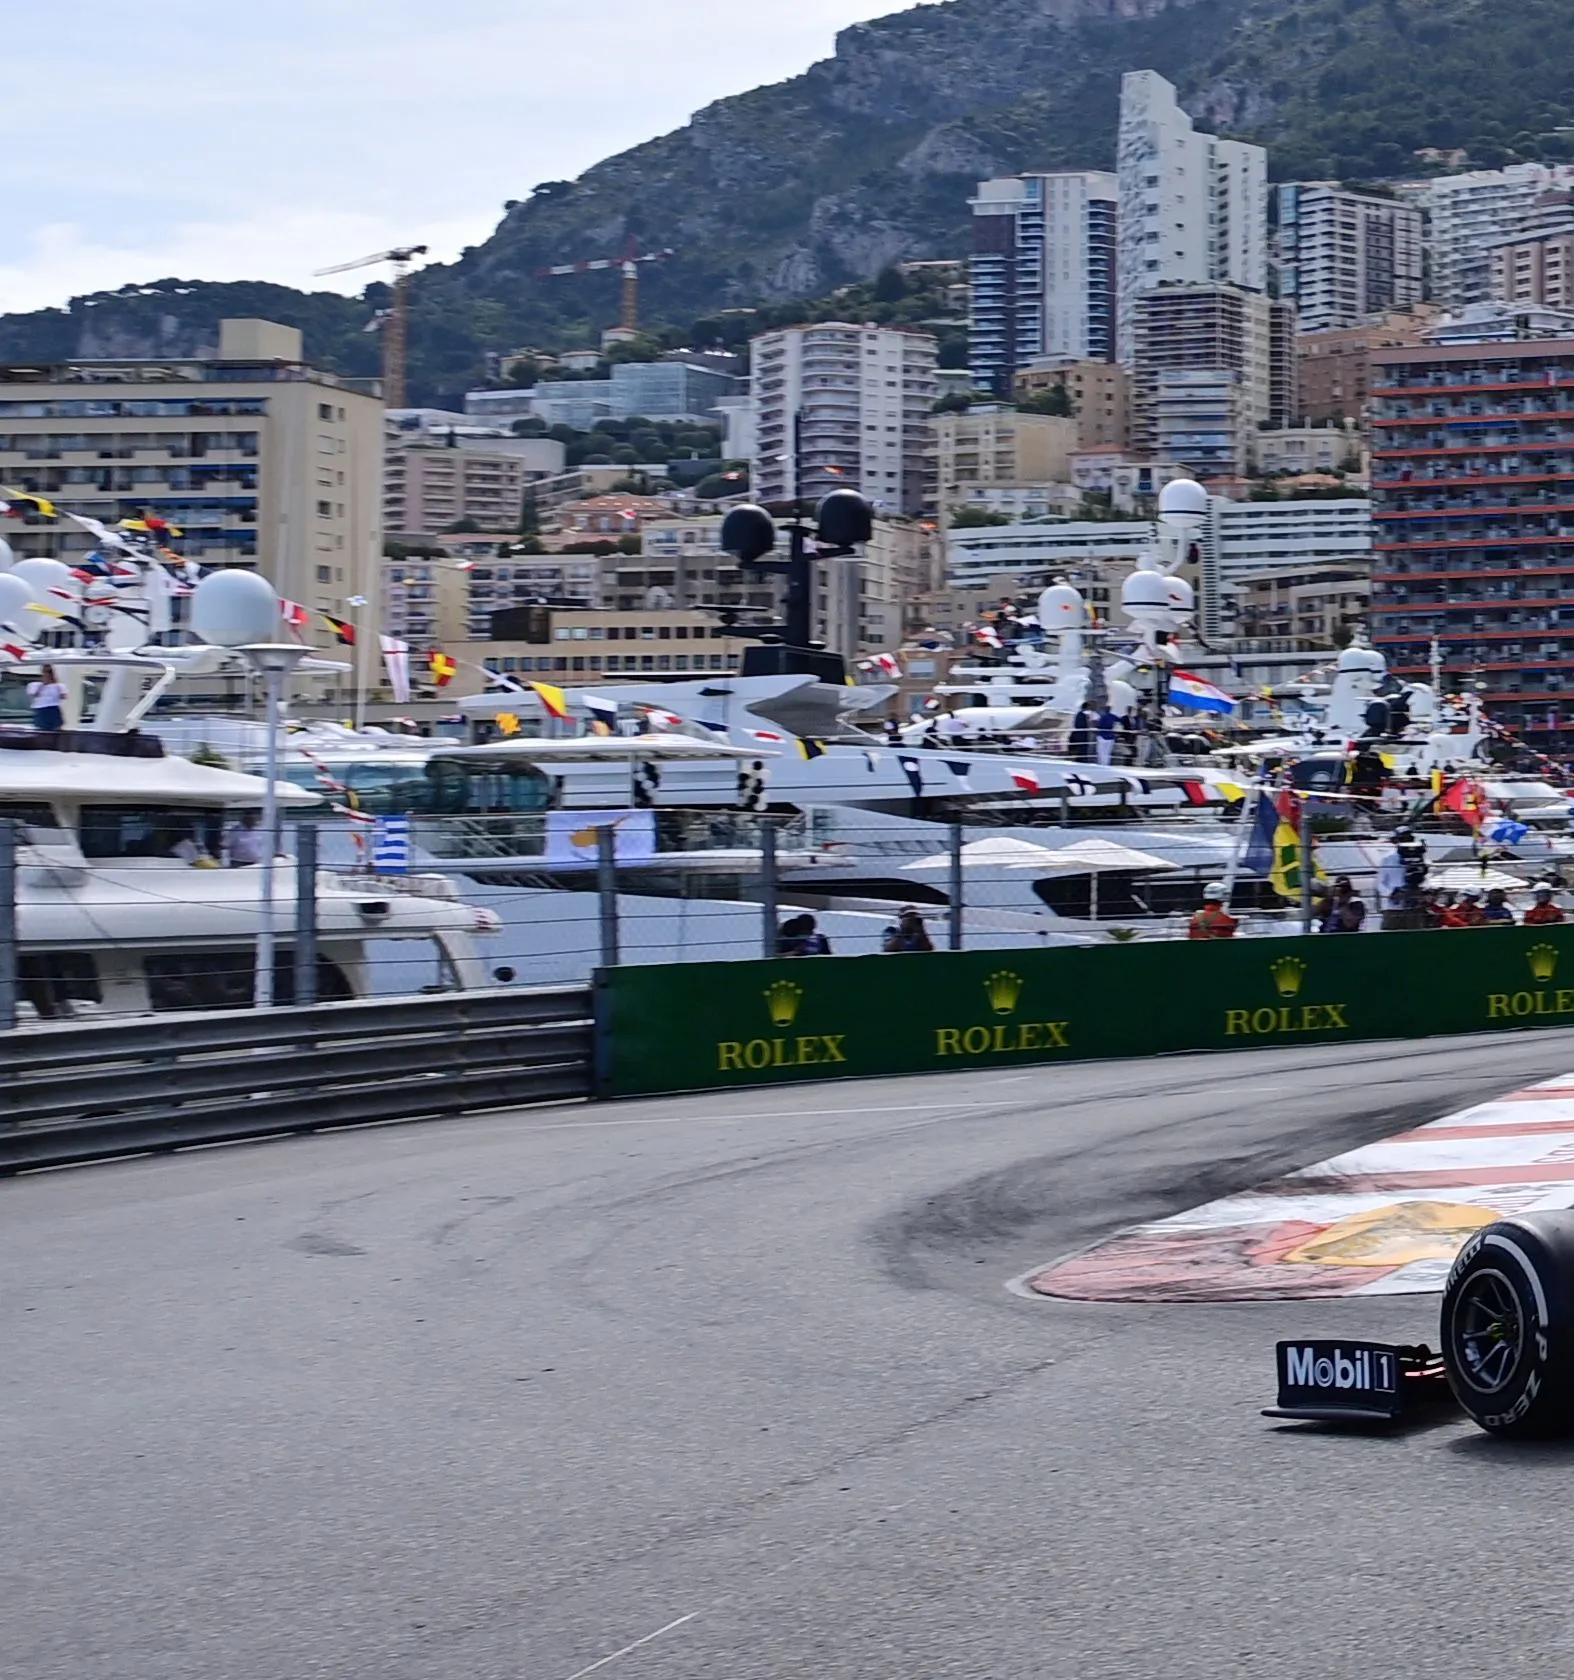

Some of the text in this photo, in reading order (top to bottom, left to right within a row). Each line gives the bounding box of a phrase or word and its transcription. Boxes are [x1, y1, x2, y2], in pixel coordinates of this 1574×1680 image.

[1225, 1004, 1349, 1035] ROLEX
[717, 1035, 847, 1071] ROLEX
[934, 1021, 1070, 1057] ROLEX
[1286, 1345, 1371, 1390] Mobil
